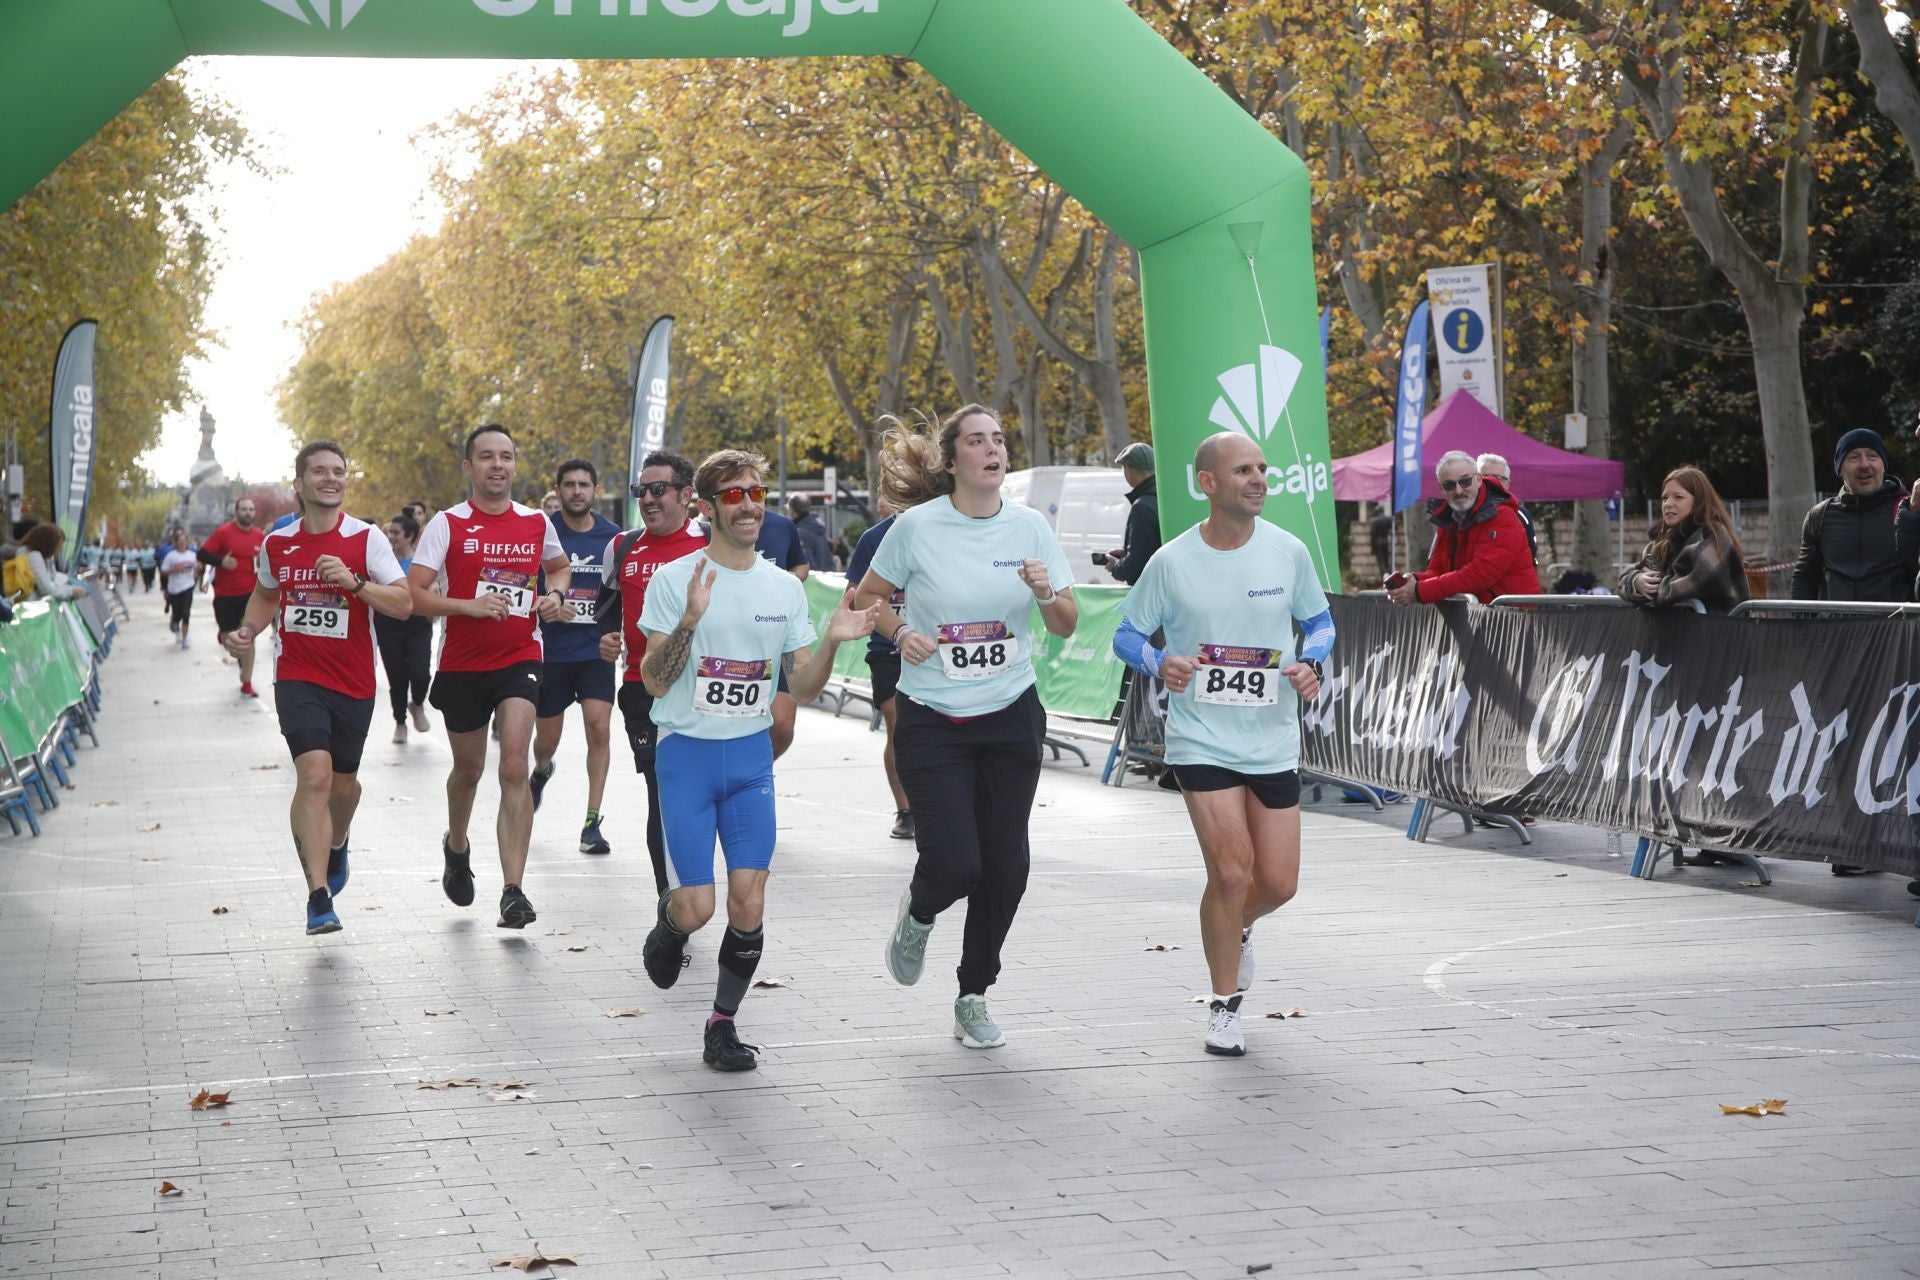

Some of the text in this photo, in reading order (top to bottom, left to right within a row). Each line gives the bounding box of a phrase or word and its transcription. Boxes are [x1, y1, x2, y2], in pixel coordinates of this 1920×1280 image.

[483, 543, 536, 555] EIFFAGE
[1248, 586, 1284, 598] OneHealth
[293, 608, 338, 629] 259
[754, 614, 787, 623] OneHealth
[951, 643, 1006, 669] 848
[706, 681, 760, 707] 850
[1207, 668, 1265, 697] 849
[1526, 652, 1605, 776] El
[1601, 650, 1765, 802] Norte
[1767, 681, 1848, 810] de
